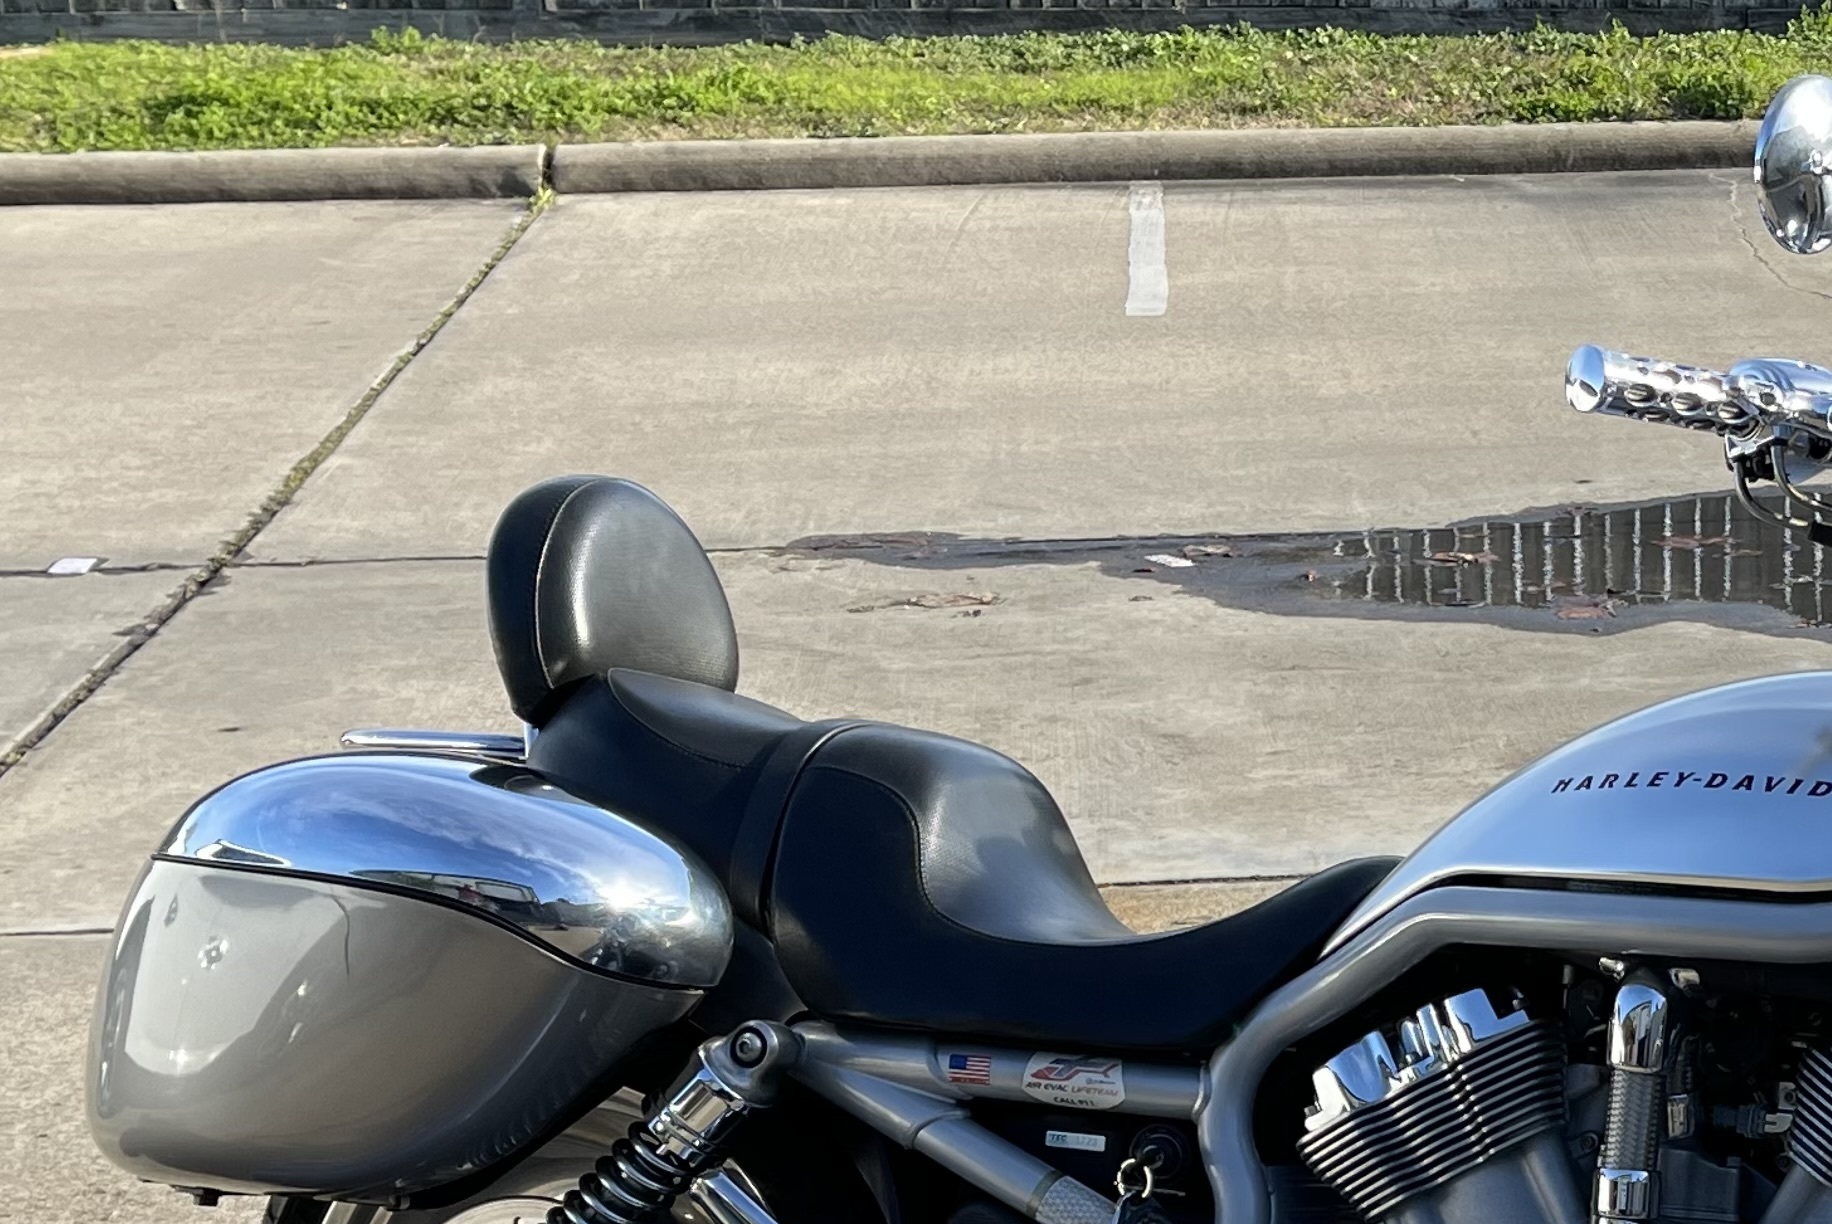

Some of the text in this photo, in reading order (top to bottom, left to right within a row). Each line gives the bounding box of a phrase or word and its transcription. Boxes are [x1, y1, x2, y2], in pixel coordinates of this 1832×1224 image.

[1026, 1081, 1119, 1096] AIR EVAC LIFETEAM
[1053, 1096, 1077, 1105] CALL
